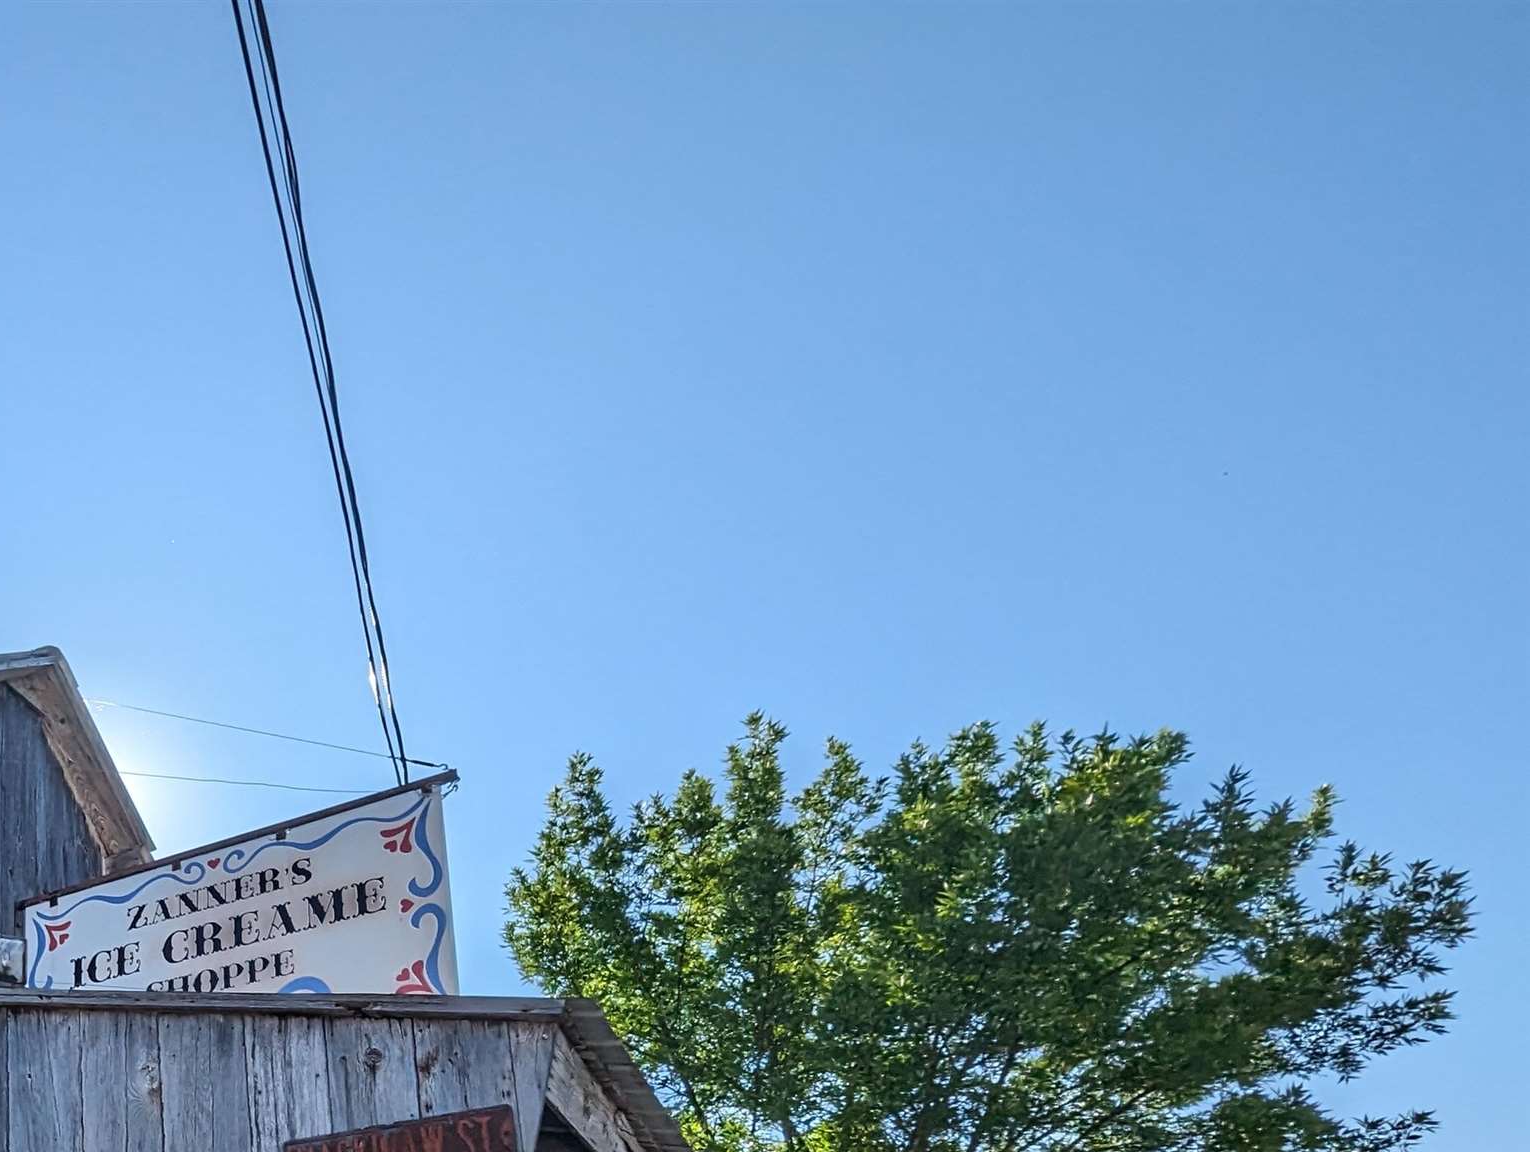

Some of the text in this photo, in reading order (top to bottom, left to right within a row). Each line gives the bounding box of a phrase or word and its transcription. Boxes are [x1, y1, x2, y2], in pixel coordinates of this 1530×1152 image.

[69, 876, 387, 991] ICE CREAME
[127, 858, 312, 931] ZANNER'S
